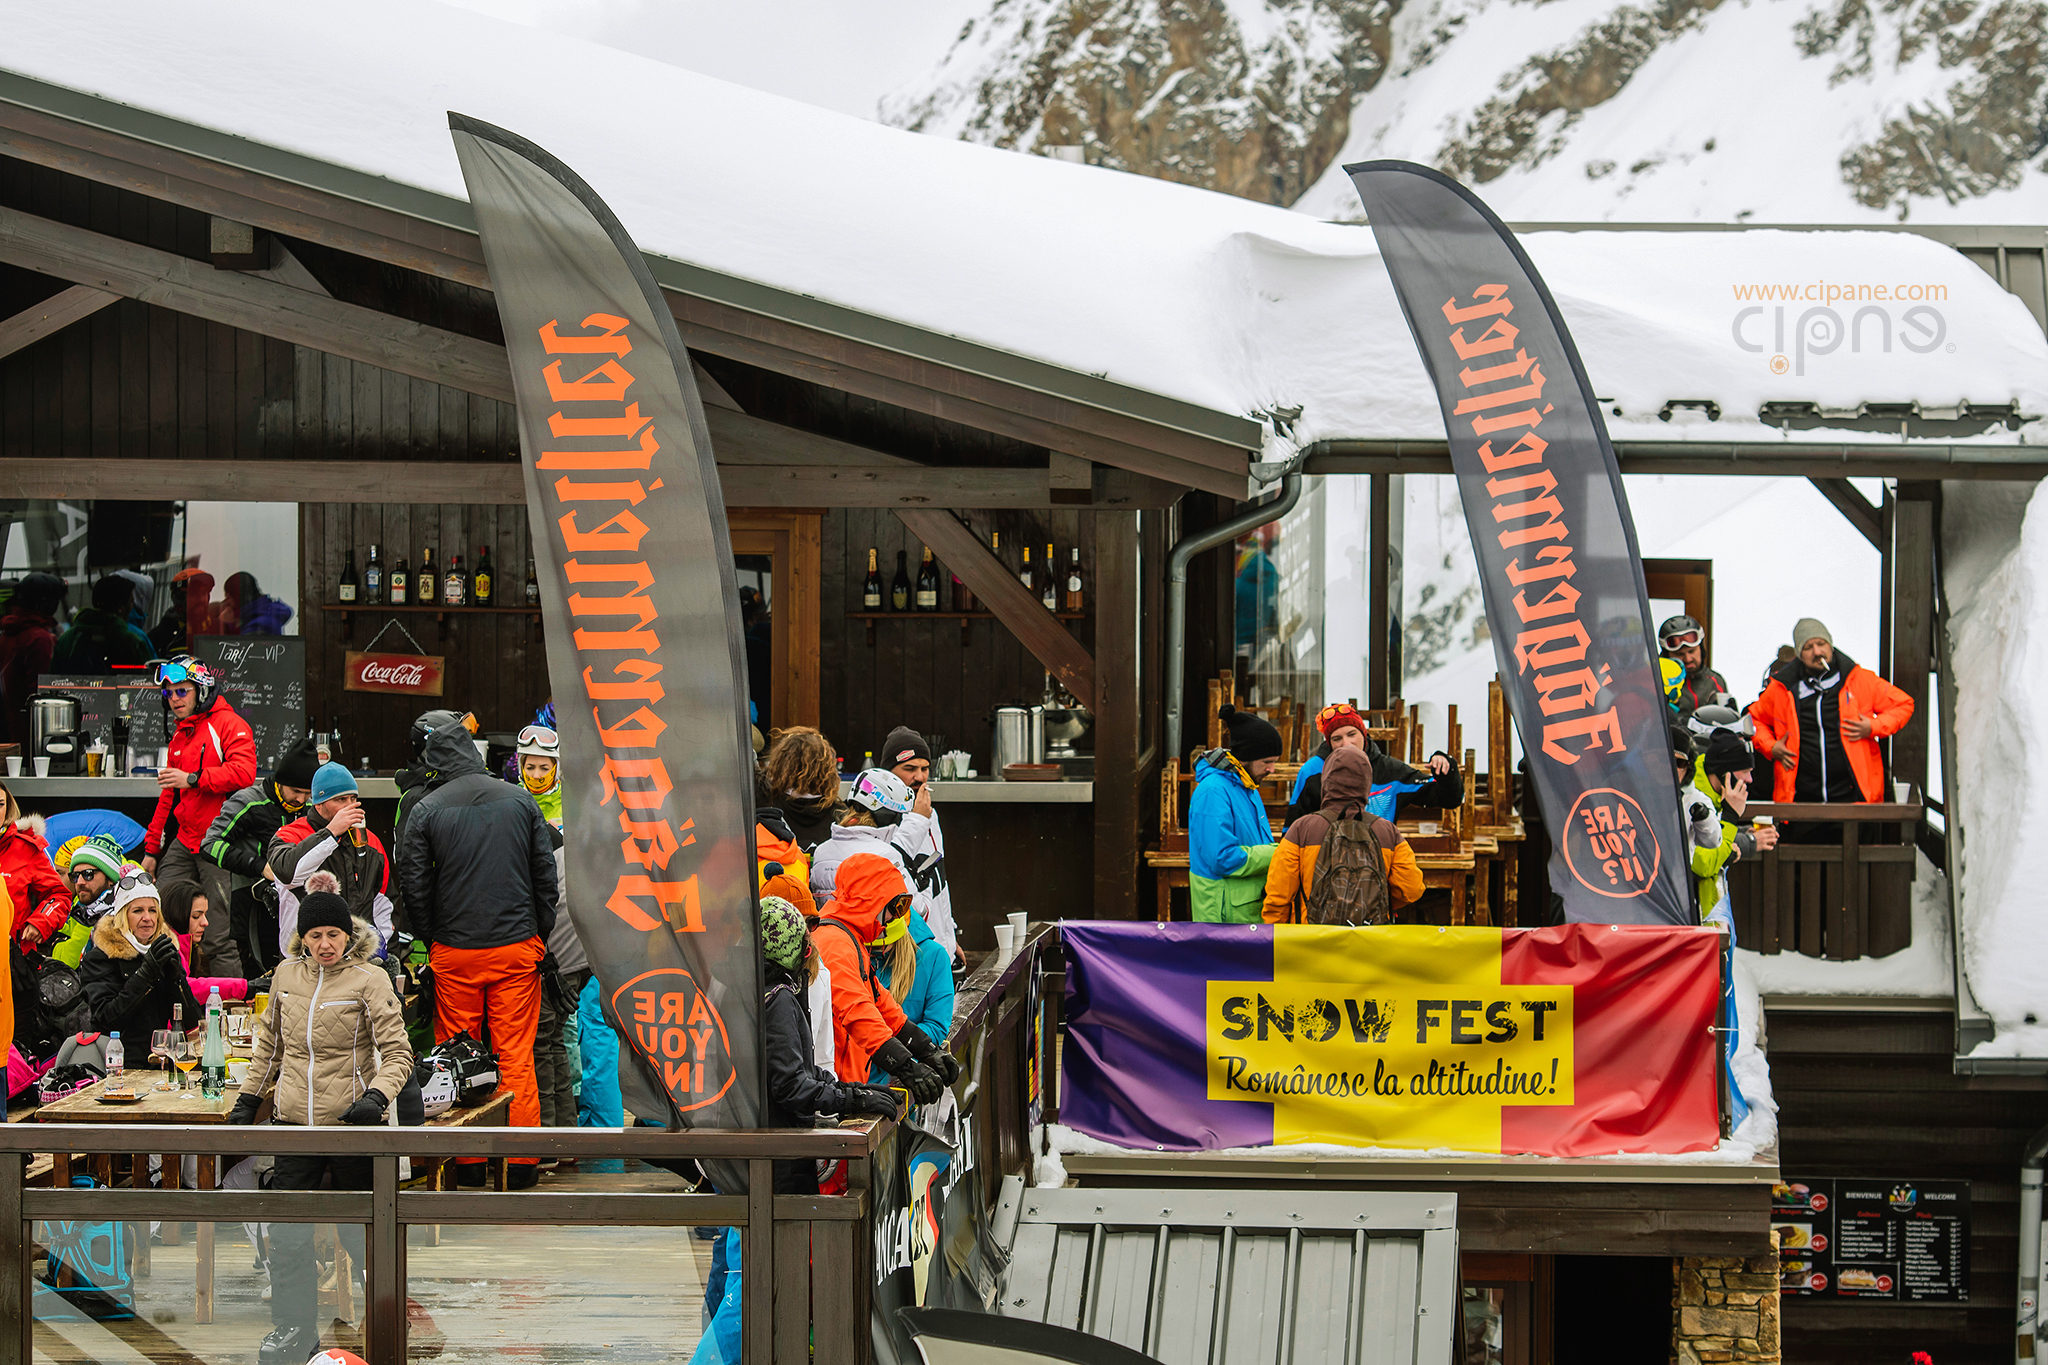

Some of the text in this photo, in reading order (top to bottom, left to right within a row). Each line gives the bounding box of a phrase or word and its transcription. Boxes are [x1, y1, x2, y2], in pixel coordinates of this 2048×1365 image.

[218, 641, 286, 671] Tarif VIP
[361, 662, 426, 686] Coca-Cola
[1221, 995, 1557, 1045] SNOW FEST
[1218, 1056, 1559, 1097] Românesc la altitudine!
[1846, 1192, 1883, 1200] BIENVENUE
[1924, 1193, 1957, 1201] WELCOME
